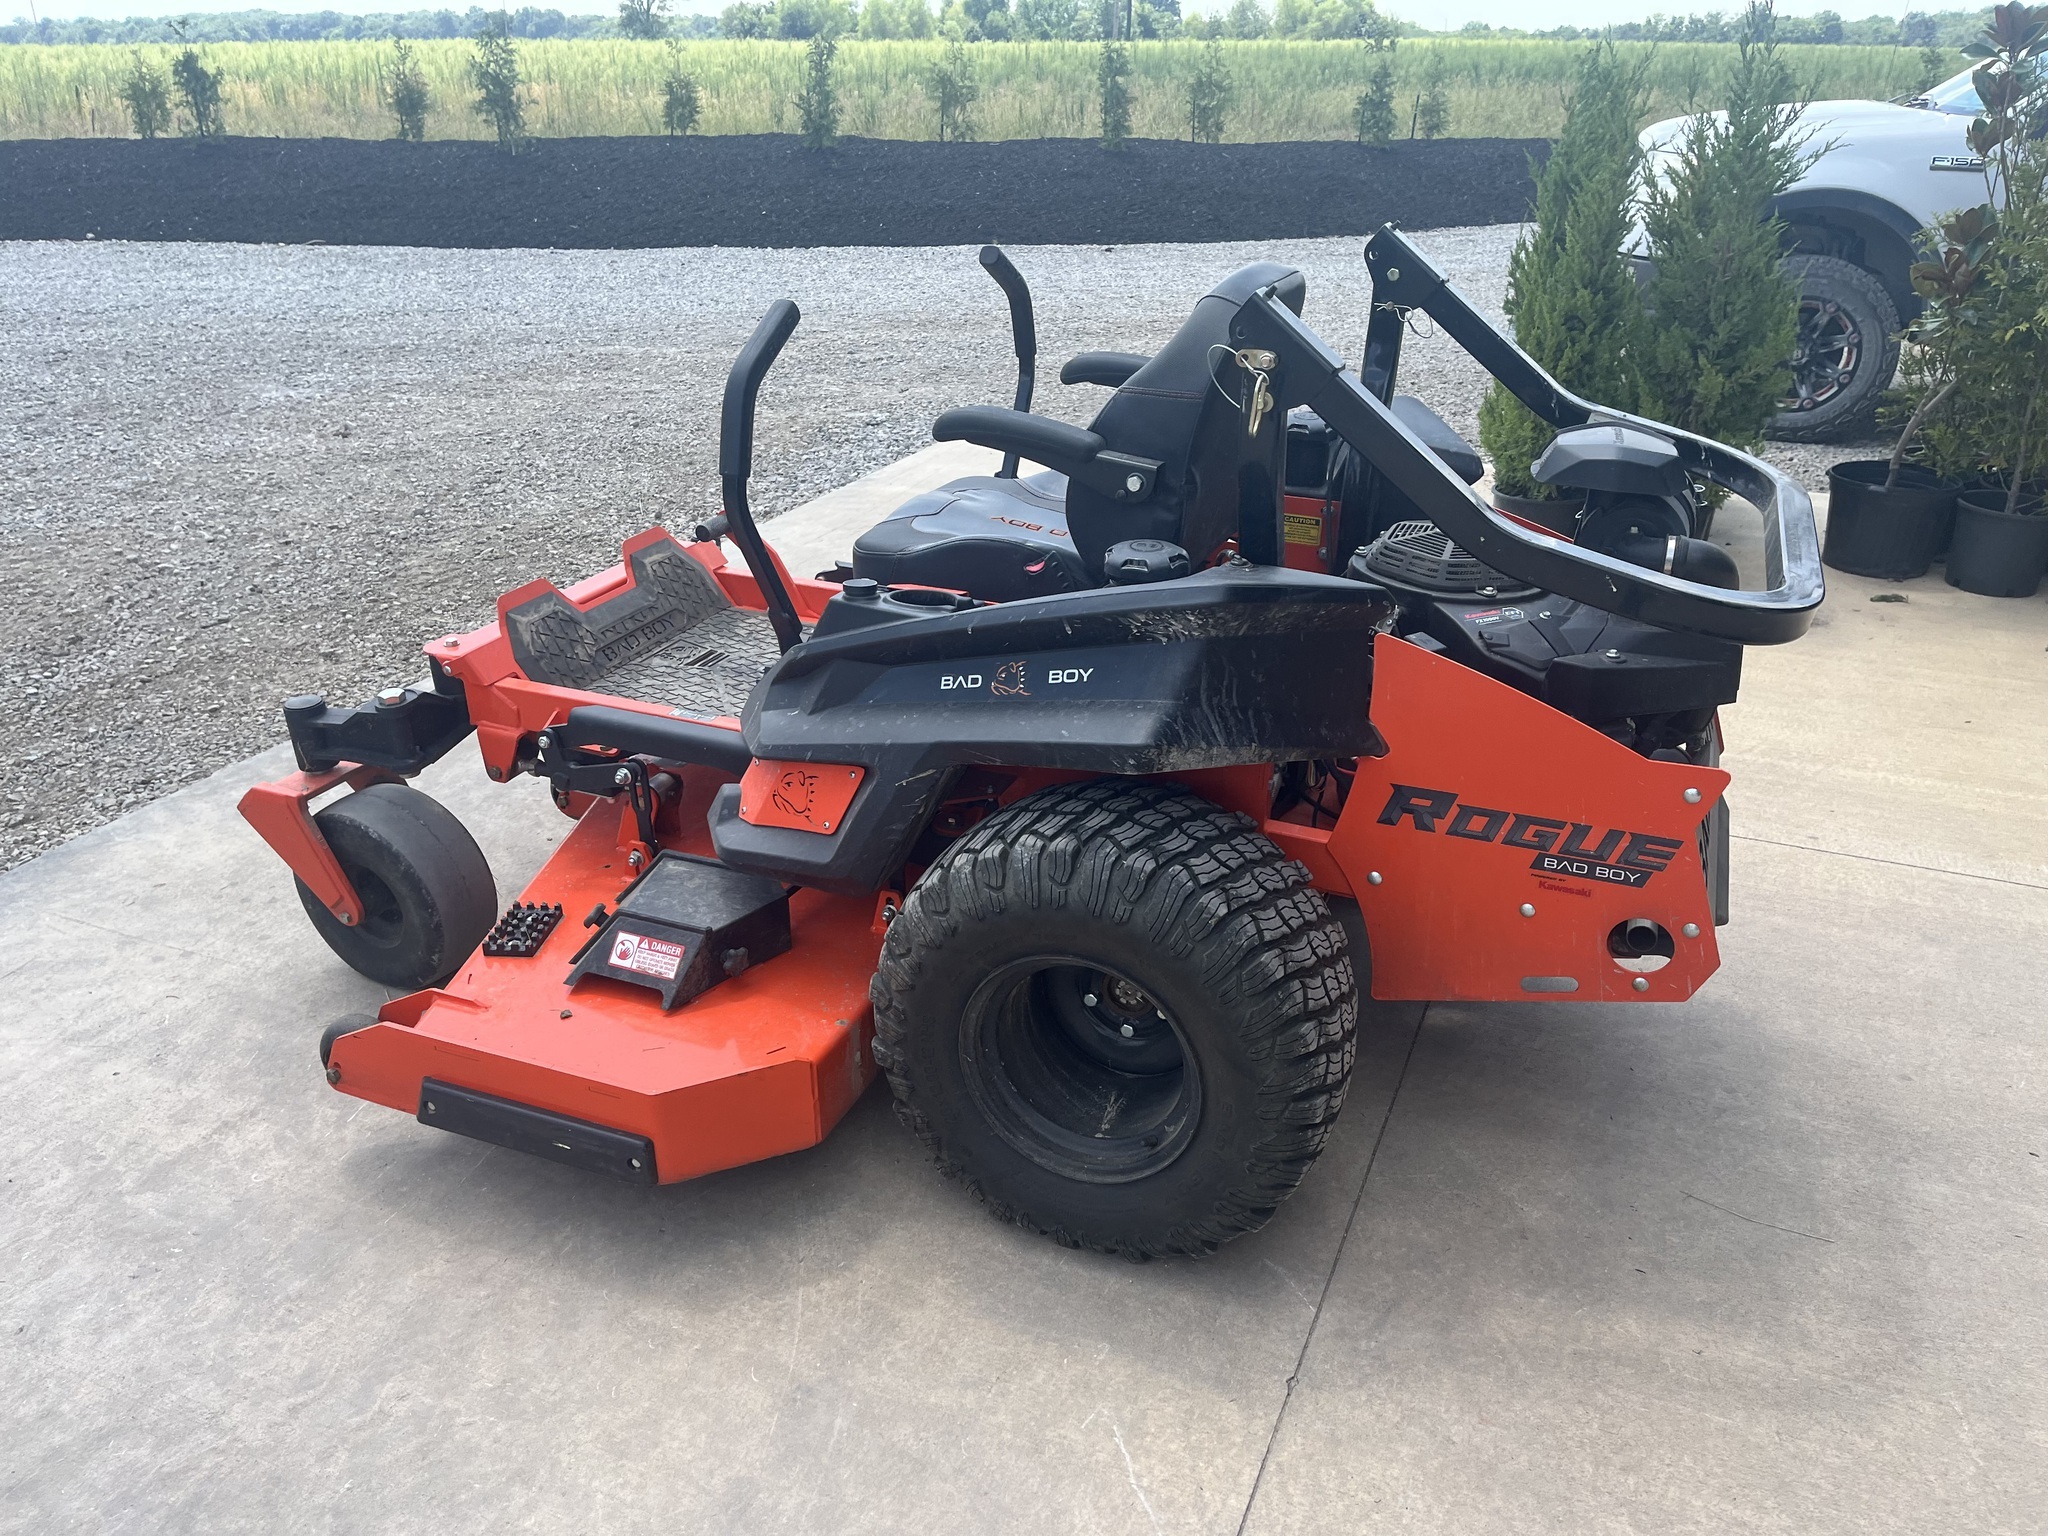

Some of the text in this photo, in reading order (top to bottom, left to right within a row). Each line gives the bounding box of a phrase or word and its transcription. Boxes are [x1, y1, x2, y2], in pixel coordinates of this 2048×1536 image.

[1284, 516, 1316, 525] CAUTION
[602, 614, 675, 662] BAD BOY
[940, 668, 1094, 690] BAD BOY
[1376, 783, 1685, 872] ROGUE
[1543, 857, 1642, 883] BAD BOY
[1538, 880, 1593, 898] Kawasaki
[651, 941, 682, 957] DANGER
